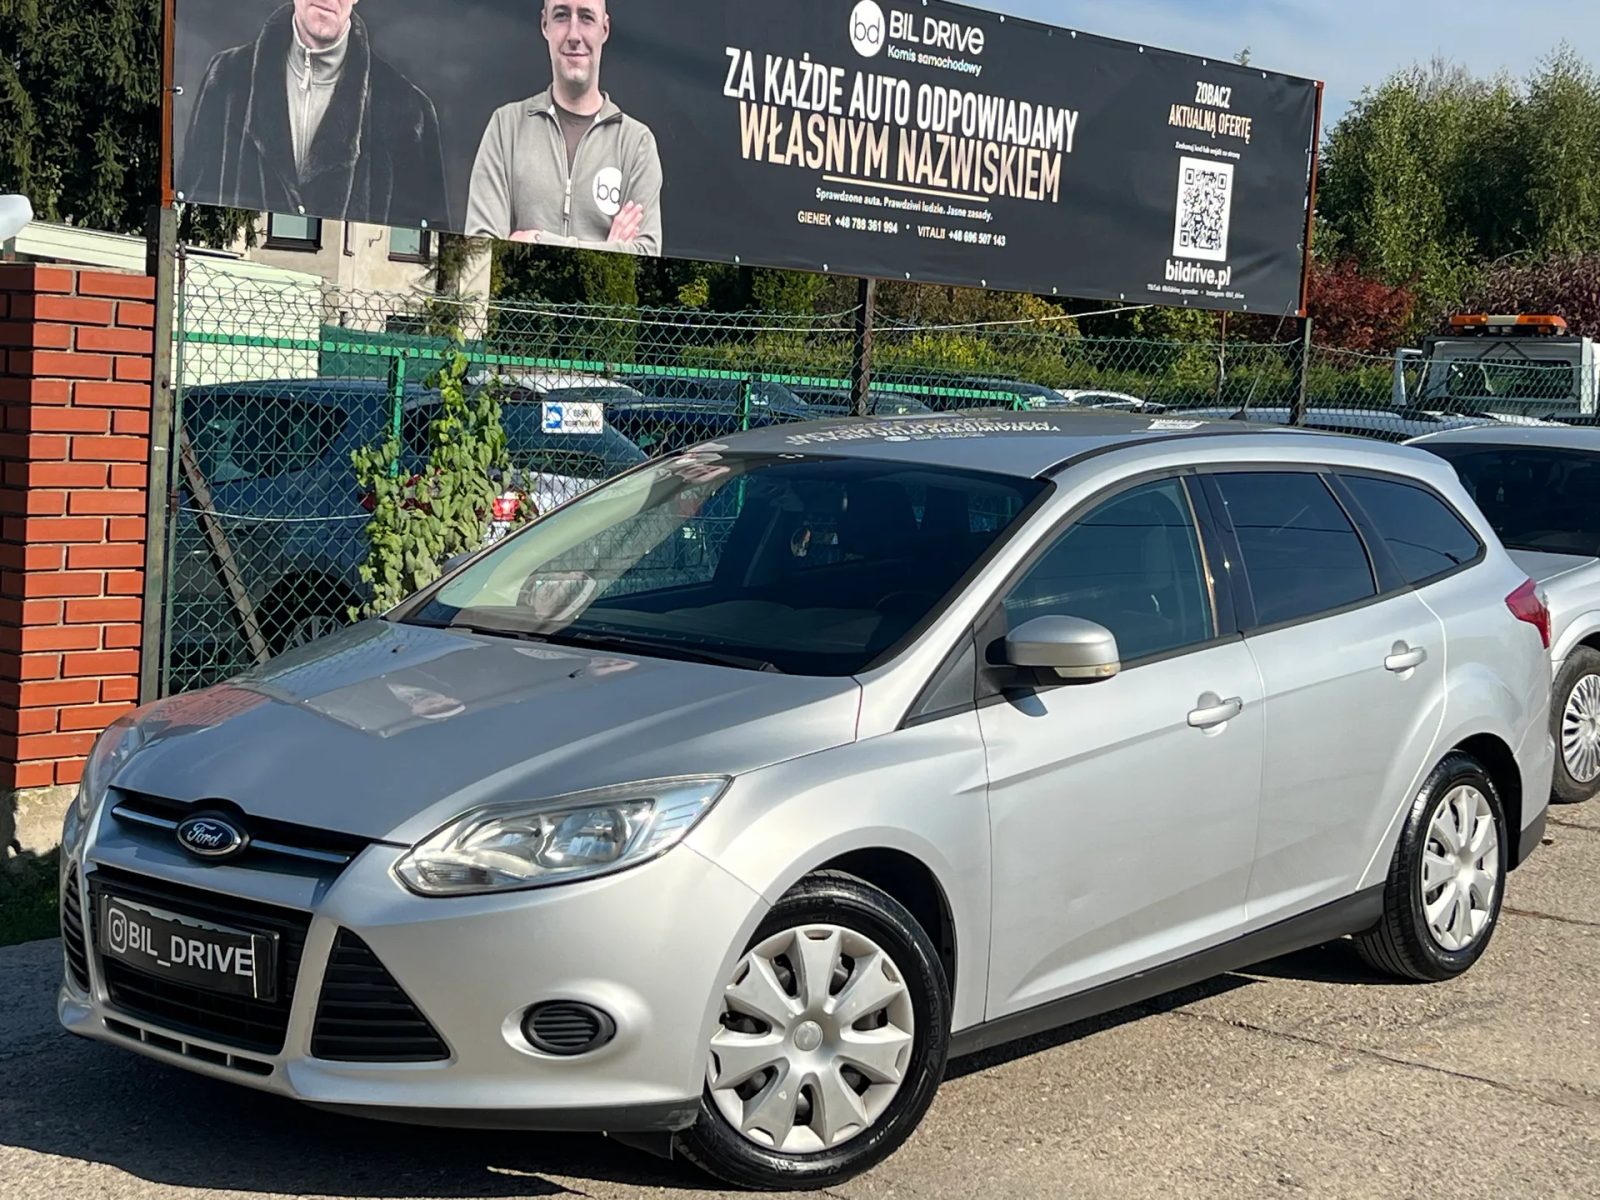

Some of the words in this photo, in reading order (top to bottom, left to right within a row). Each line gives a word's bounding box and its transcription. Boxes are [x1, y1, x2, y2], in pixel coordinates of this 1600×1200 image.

[889, 9, 919, 43] BIL
[887, 44, 916, 63] Komis
[917, 52, 982, 77] samochodowy
[723, 46, 756, 101] ZA
[764, 52, 845, 116] KAŻDE
[848, 70, 911, 126] AUTO
[916, 83, 1079, 153] ODPOWIADAMY
[1194, 81, 1232, 109] ZOBACZ
[1168, 103, 1216, 139] AKTUALNĄ
[1218, 112, 1252, 144] OFERTĘ
[739, 100, 889, 179] WŁASNYM
[896, 127, 1062, 203] NAZWISKIEM
[815, 187, 863, 204] Sprawdzone
[863, 195, 882, 207] auta.
[883, 196, 921, 211] Prawdziwi
[921, 200, 946, 215] ludzie.
[946, 205, 967, 217] Jasne
[967, 209, 993, 223] zasady.
[797, 210, 832, 227] GIENEK
[834, 215, 850, 229] +48
[867, 219, 881, 232] 361
[978, 232, 992, 245] 507
[992, 234, 1006, 247] 143
[1165, 259, 1232, 290] bildrive.pl
[186, 822, 223, 848] Ford
[129, 920, 253, 977] BIL_DRIVE
